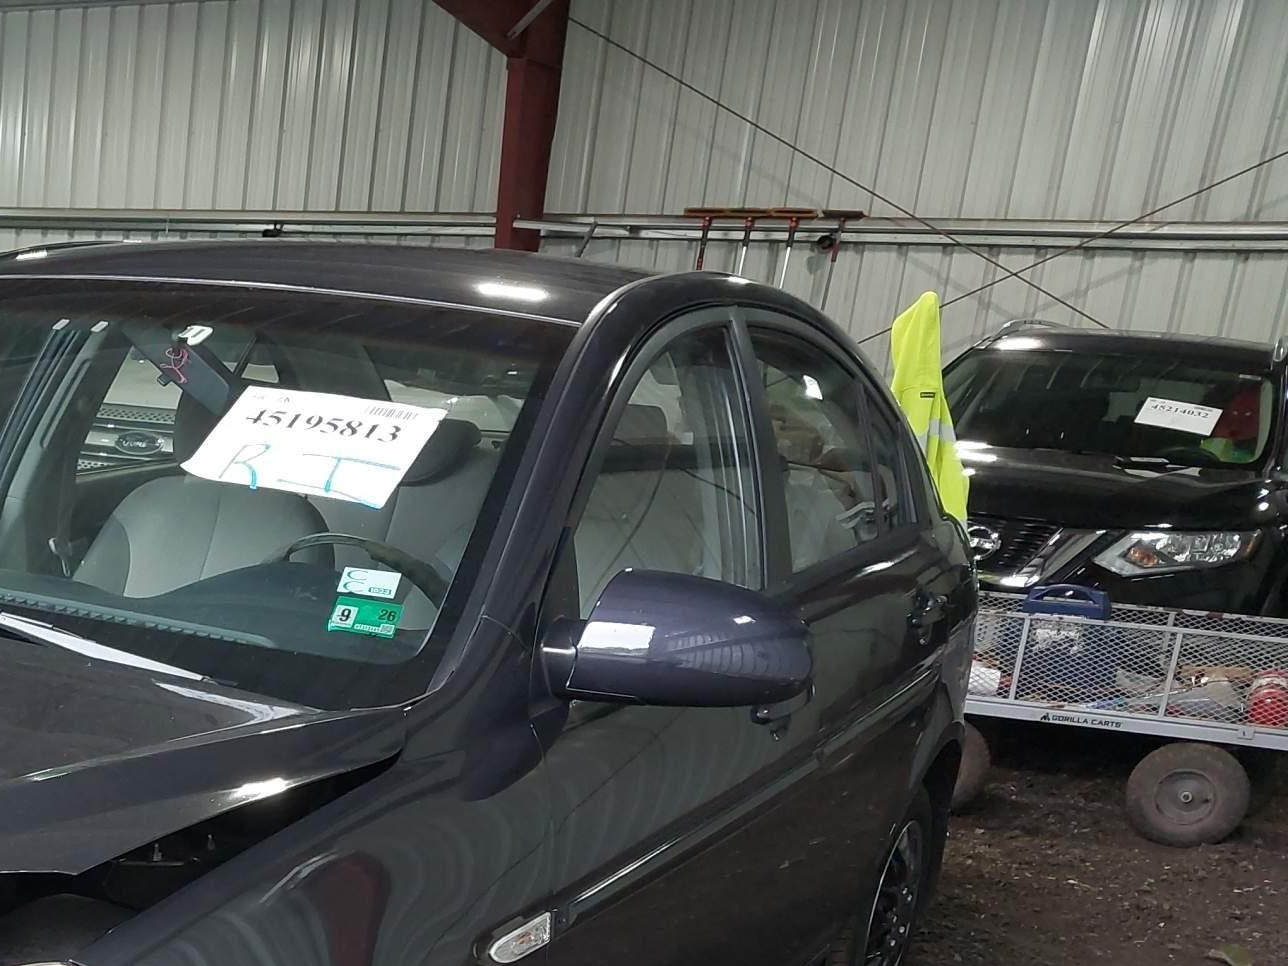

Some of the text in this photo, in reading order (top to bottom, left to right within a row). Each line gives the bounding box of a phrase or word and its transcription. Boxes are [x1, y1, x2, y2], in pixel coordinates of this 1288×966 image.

[246, 408, 402, 443] 45195813
[339, 608, 397, 622] 9 26
[1052, 715, 1121, 728] GORILLA CARTS
